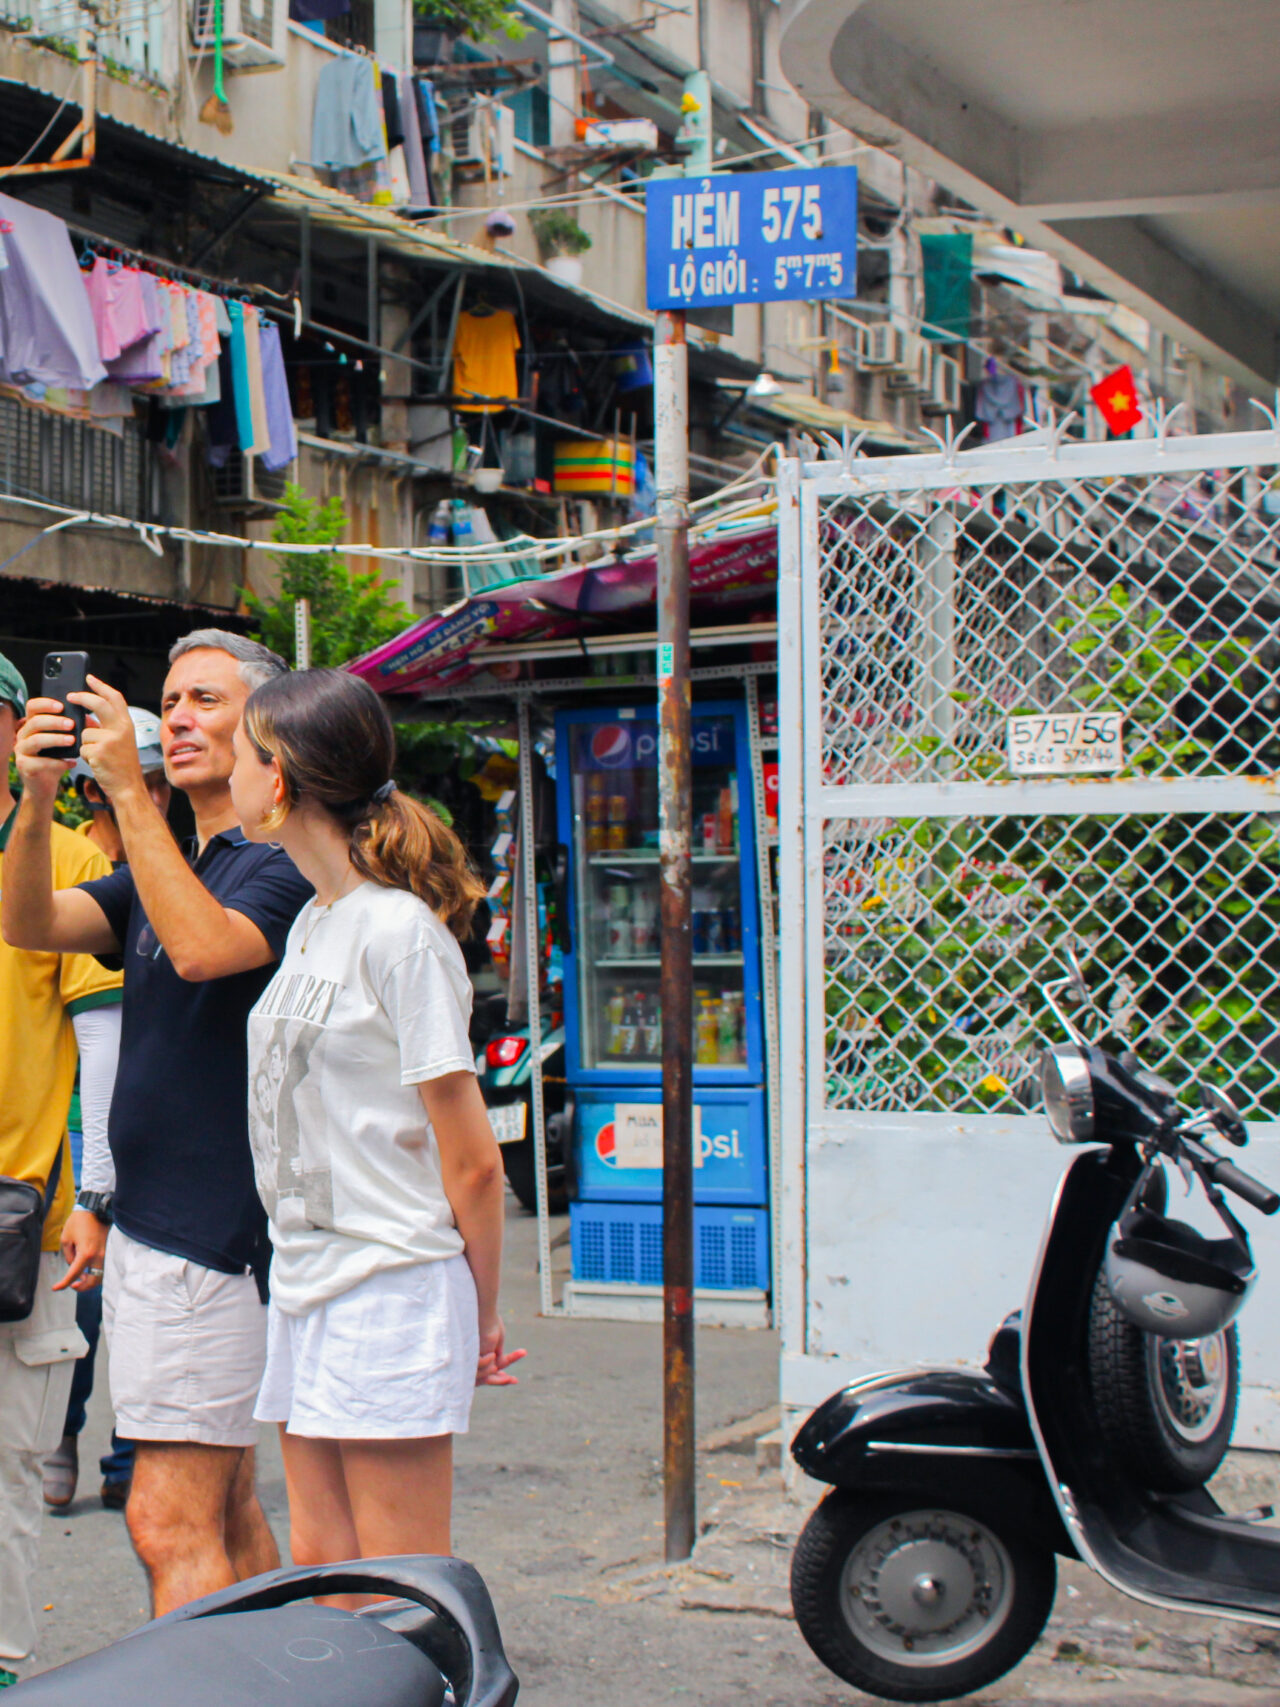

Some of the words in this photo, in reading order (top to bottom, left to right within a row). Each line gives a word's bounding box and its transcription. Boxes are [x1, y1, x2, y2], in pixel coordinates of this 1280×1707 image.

[671, 178, 740, 250] HẺM
[761, 184, 824, 244] 575
[668, 254, 697, 302] LỘ
[636, 727, 719, 761] psi
[1012, 716, 1118, 744] 575/56
